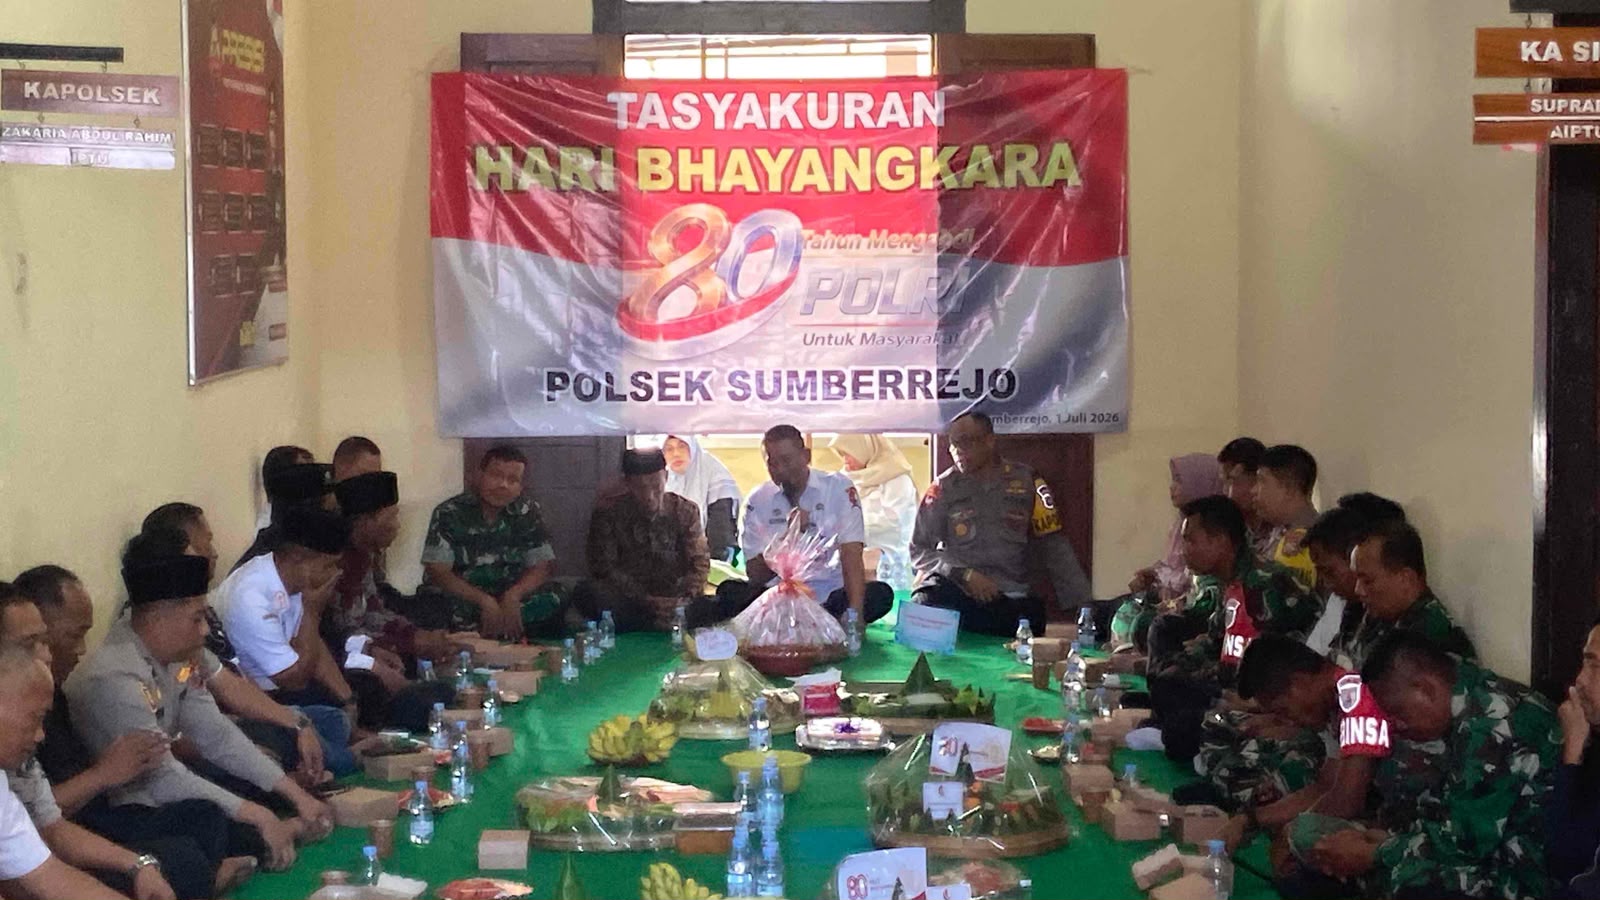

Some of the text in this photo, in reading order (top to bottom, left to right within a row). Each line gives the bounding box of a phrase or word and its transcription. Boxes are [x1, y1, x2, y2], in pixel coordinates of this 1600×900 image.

[1521, 41, 1563, 62] KA
[24, 81, 160, 105] KAPOLSEK
[607, 92, 945, 130] TASYAKURAN
[2, 126, 172, 143] ZAKARIA ABDUL RAHIM
[475, 142, 1081, 193] HARI BHAYANGKARA
[802, 228, 975, 253] Tahun Mengabdi
[628, 203, 803, 325] 80
[799, 265, 970, 316] POLRI
[802, 332, 855, 346] Untuk
[546, 369, 1017, 402] POLSEK SUMBERREJO
[1064, 412, 1087, 424] Juli
[1089, 412, 1120, 424] 2026
